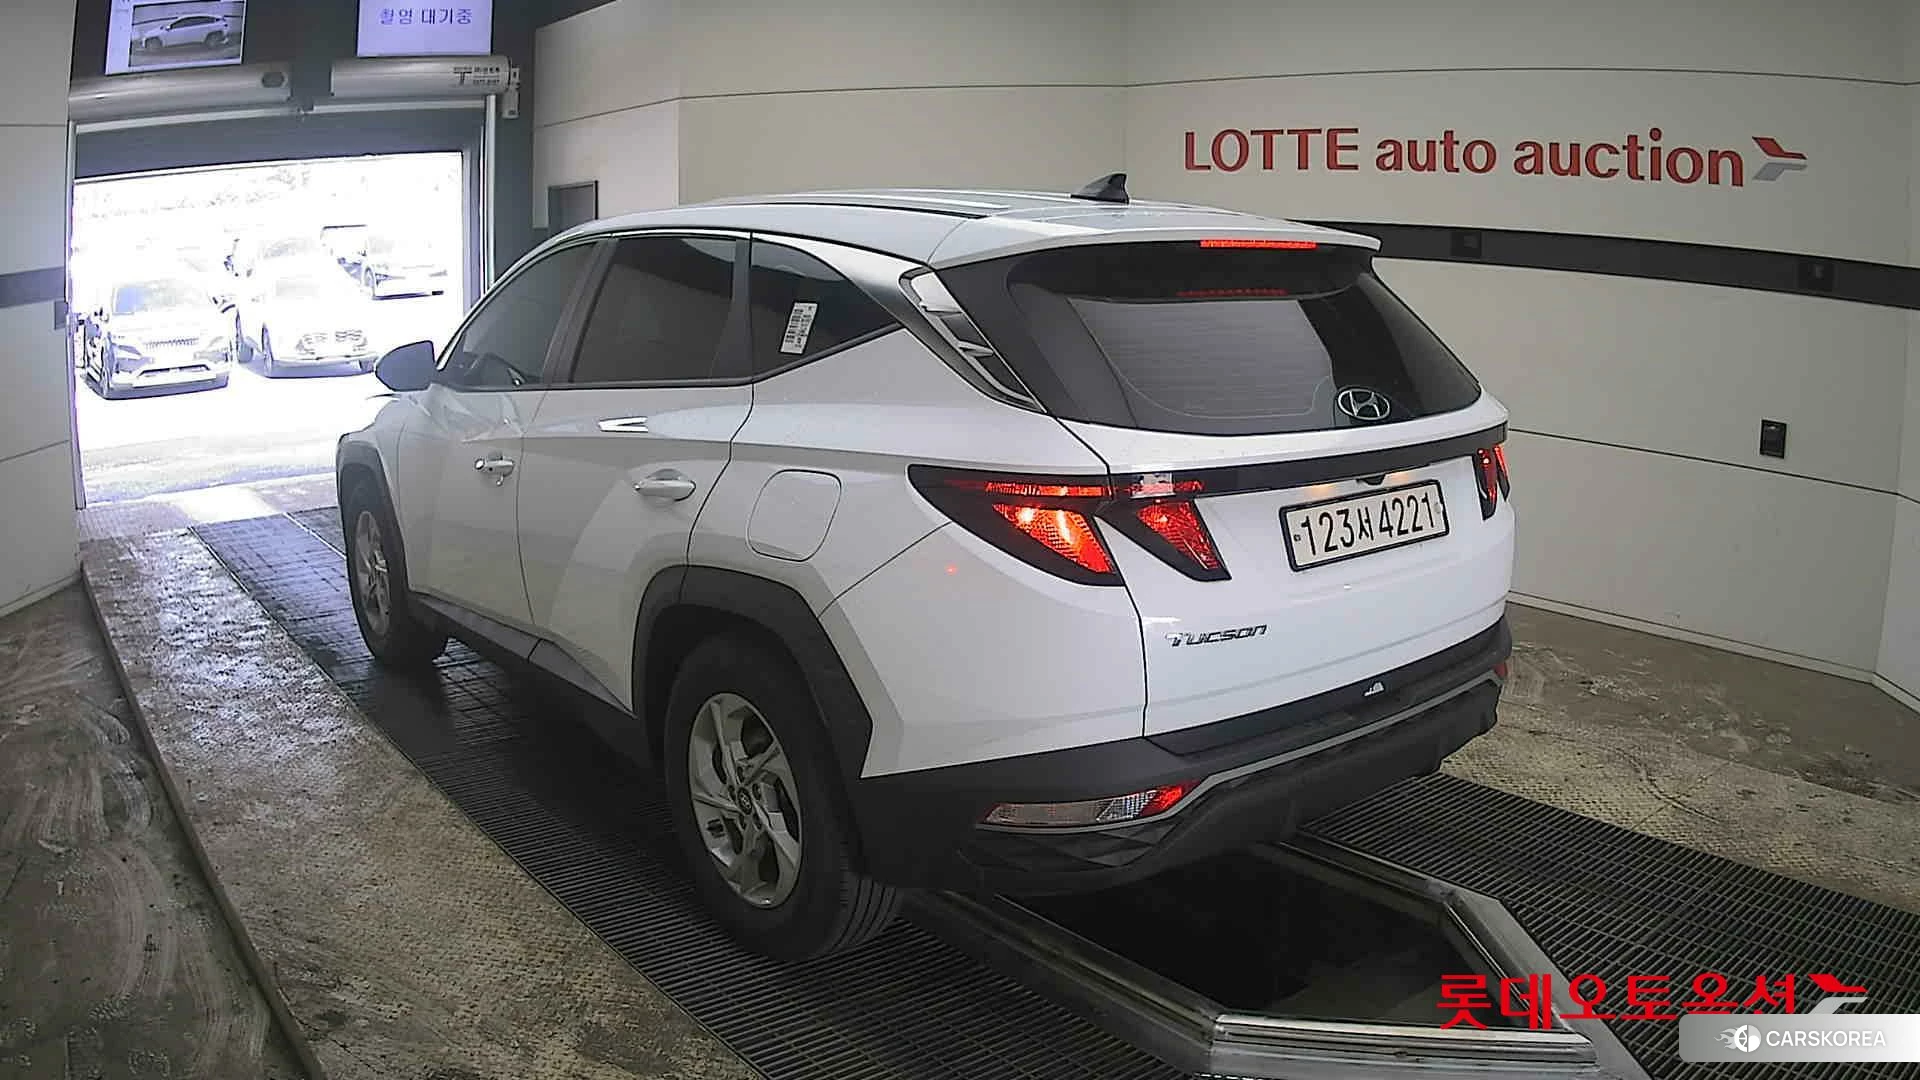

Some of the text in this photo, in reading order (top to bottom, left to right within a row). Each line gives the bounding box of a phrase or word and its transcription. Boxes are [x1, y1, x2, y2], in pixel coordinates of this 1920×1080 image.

[421, 7, 473, 25] 대기중
[1185, 127, 1744, 187] LOTTE auto auction
